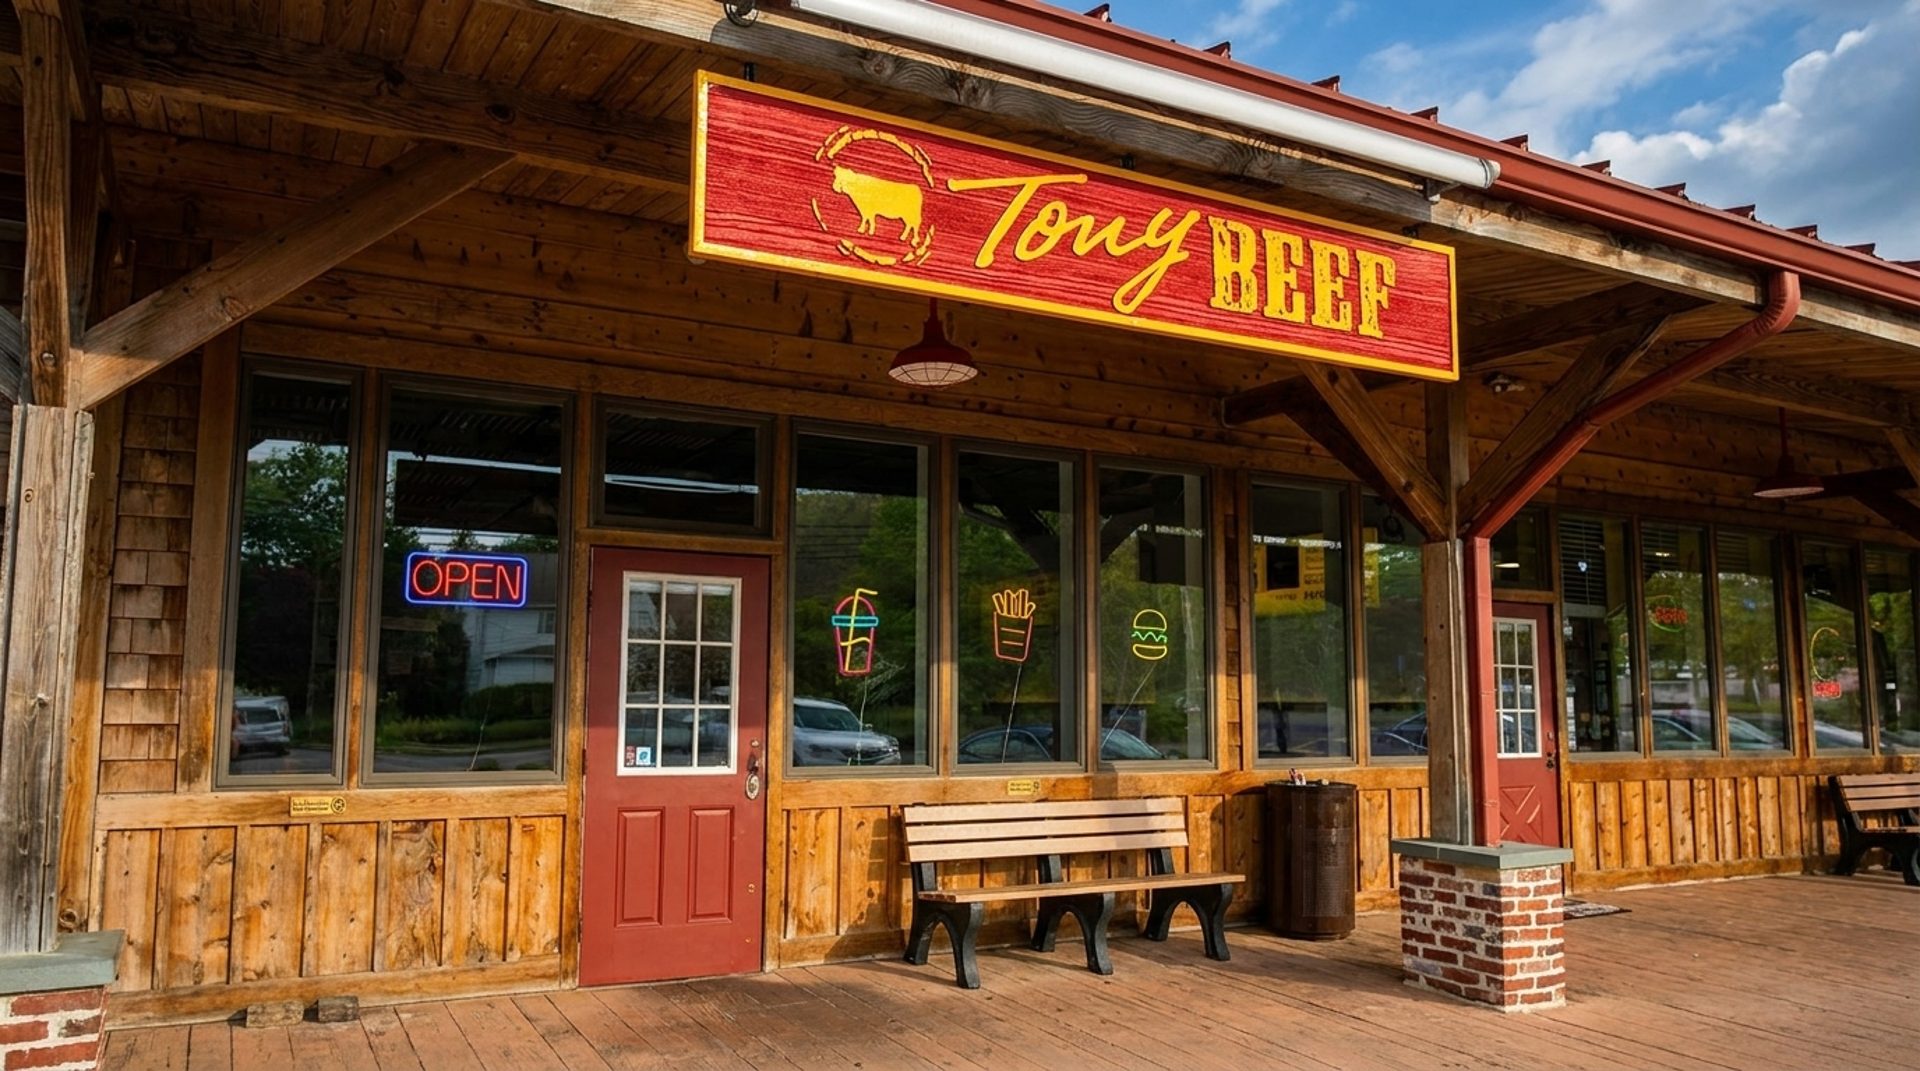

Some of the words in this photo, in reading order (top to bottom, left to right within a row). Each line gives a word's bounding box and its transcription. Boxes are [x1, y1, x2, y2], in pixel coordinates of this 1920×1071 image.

[947, 173, 1201, 315] Tony
[1207, 215, 1397, 339] BEEF
[412, 559, 521, 600] OPEN
